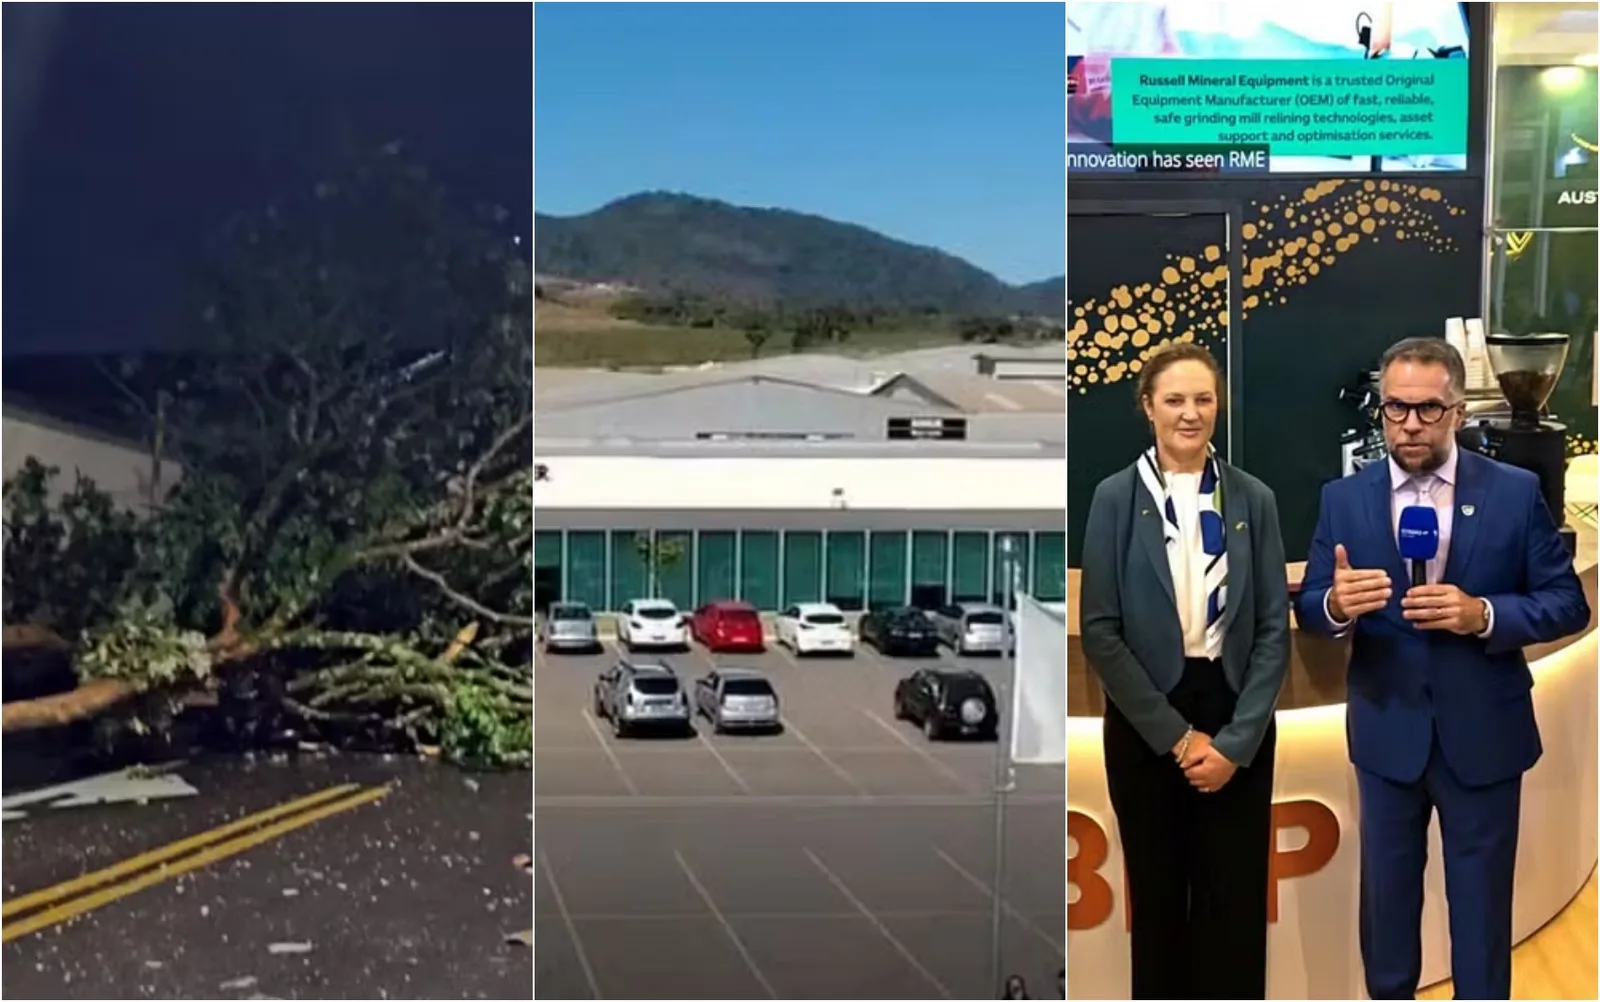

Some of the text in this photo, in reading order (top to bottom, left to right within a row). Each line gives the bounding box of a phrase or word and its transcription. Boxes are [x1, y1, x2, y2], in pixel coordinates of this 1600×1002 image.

[1139, 74, 1435, 88] Russell Mineral Equipment is a trusted Original
[1132, 93, 1434, 108] Equipment Manufacturer (OEM) of fast, reliable,
[1154, 111, 1433, 126] safe grinding mill relining technologies, asset
[1218, 129, 1433, 144] support and optimisation services.
[1152, 151, 1181, 168] has
[1186, 154, 1224, 168] seen
[1229, 151, 1265, 168] RME
[1557, 190, 1598, 204] AUS
[1067, 799, 1340, 934] BP
